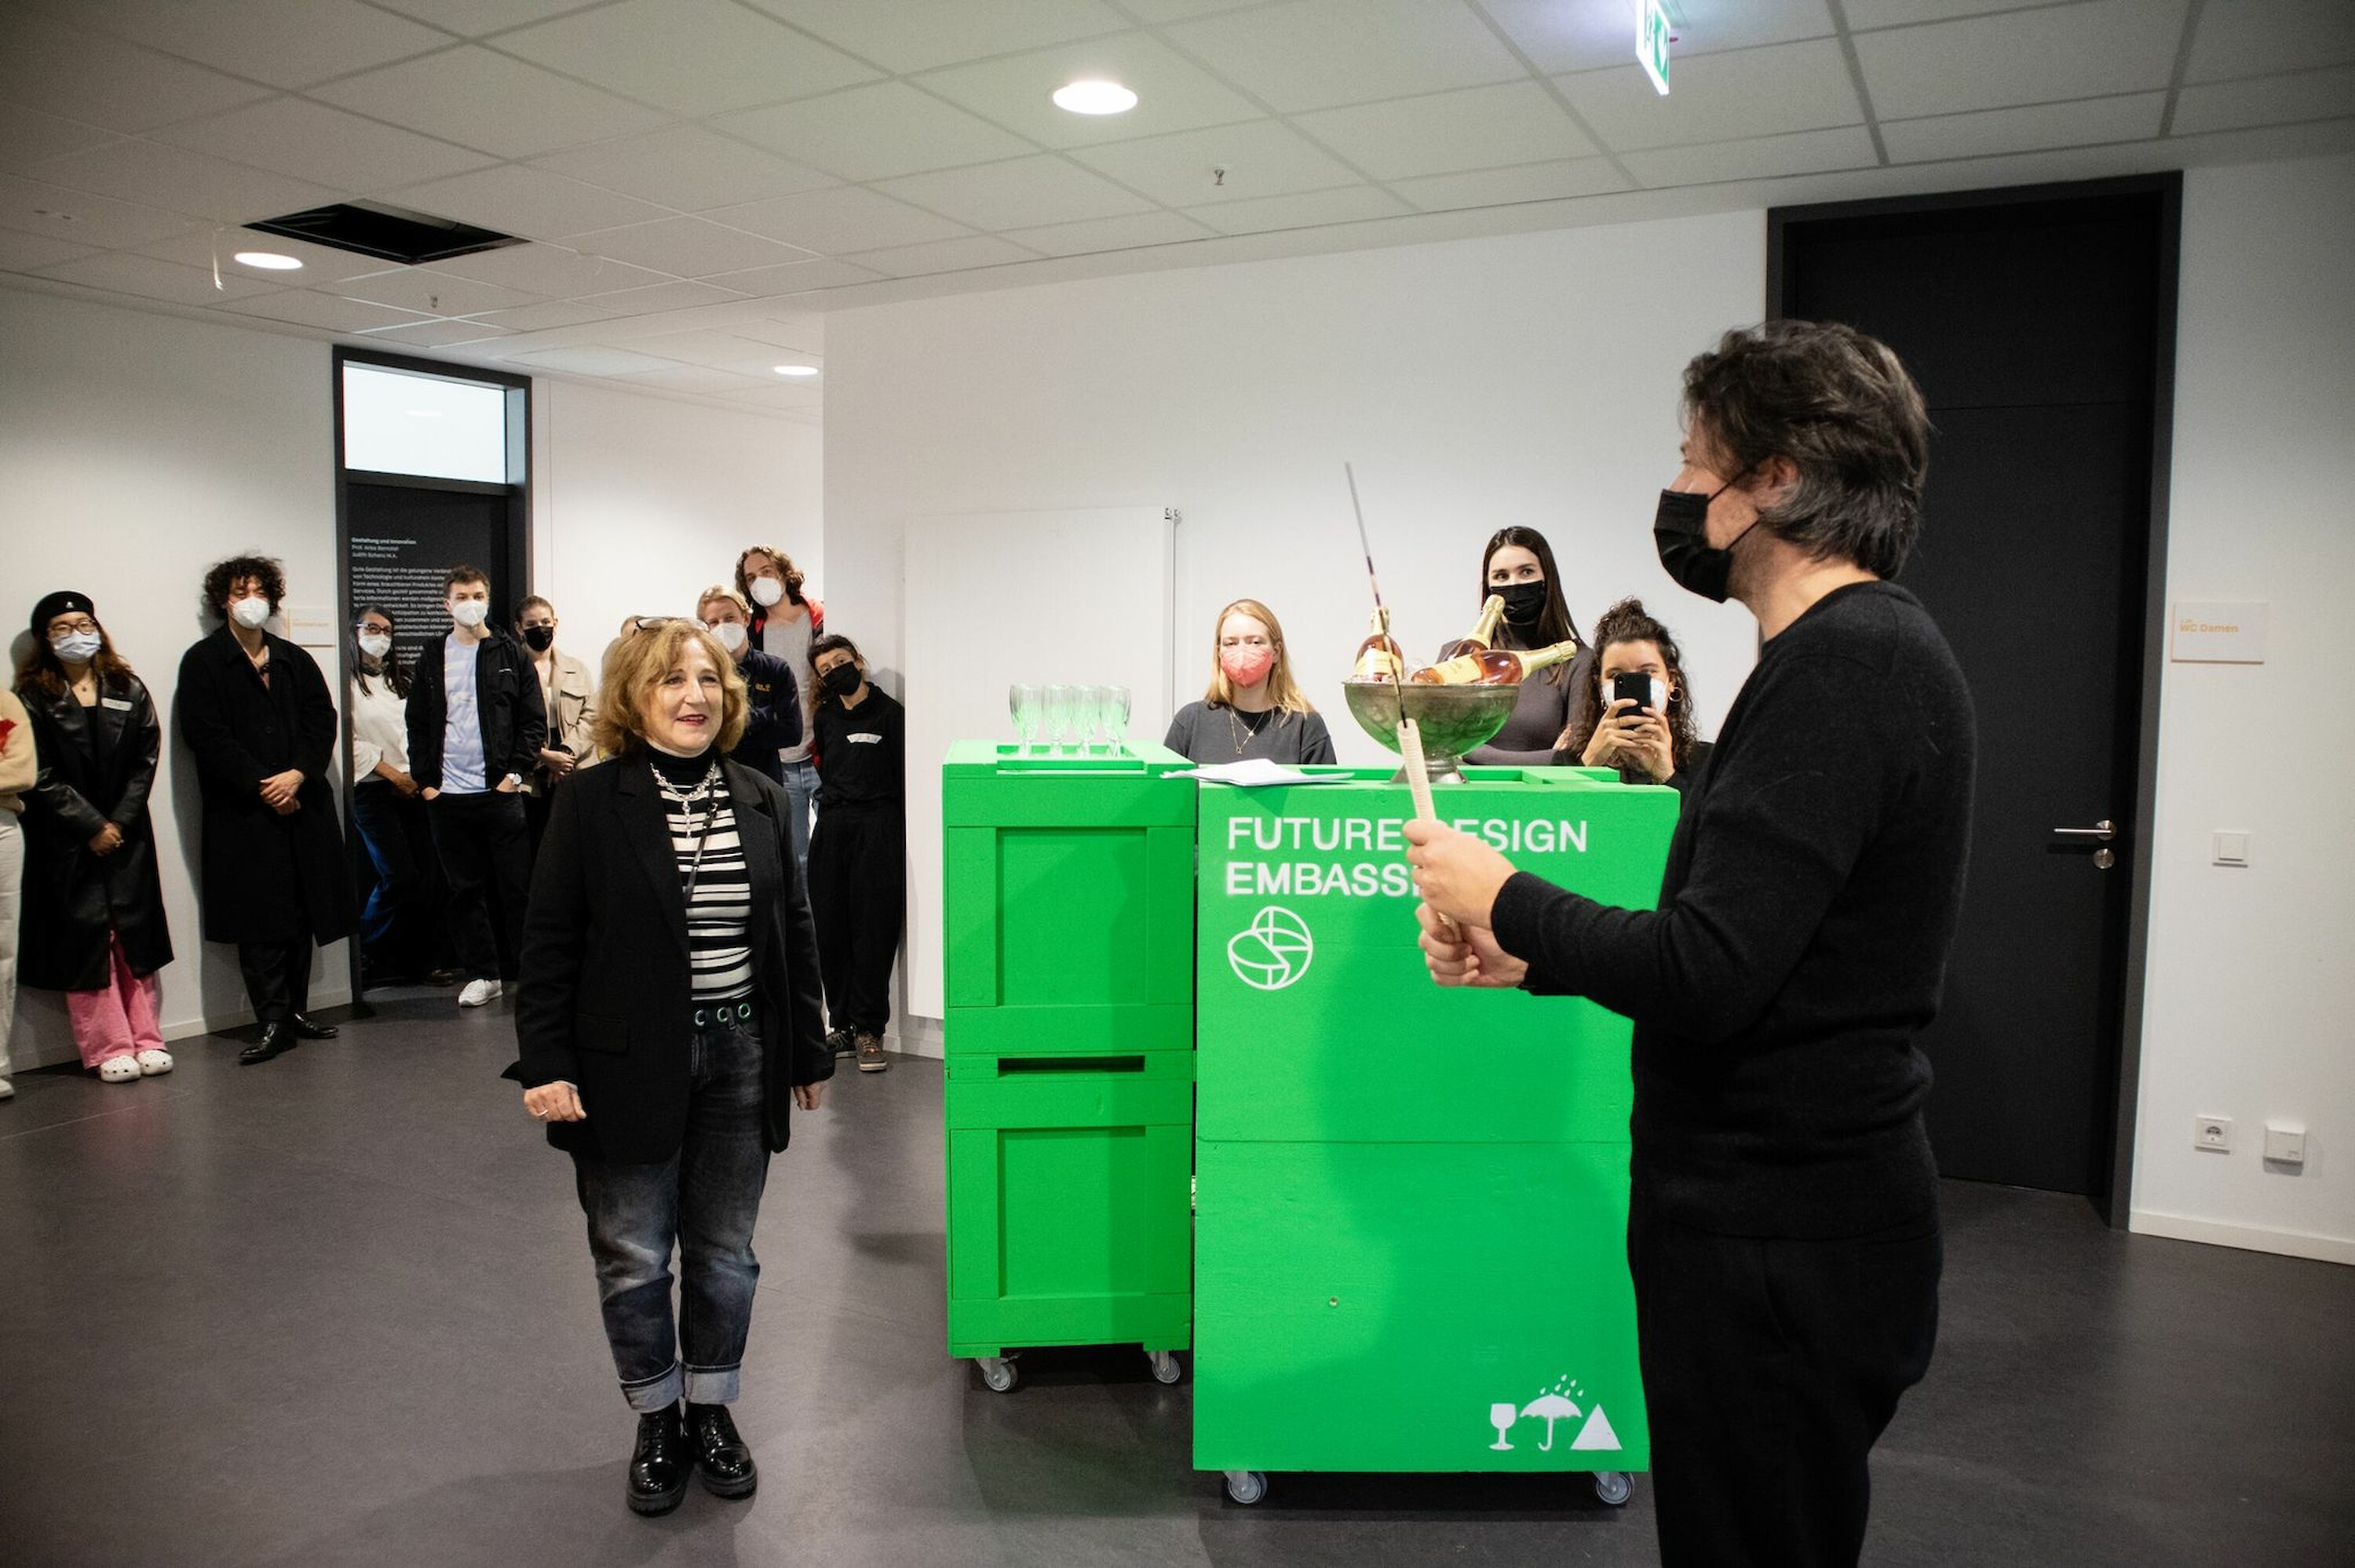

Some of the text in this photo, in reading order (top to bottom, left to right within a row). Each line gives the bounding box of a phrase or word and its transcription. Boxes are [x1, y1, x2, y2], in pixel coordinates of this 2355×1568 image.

[2200, 624, 2239, 633] Damen
[1229, 817, 1587, 852] FUTURE ESIGN
[1226, 862, 1422, 896] EMBASS
